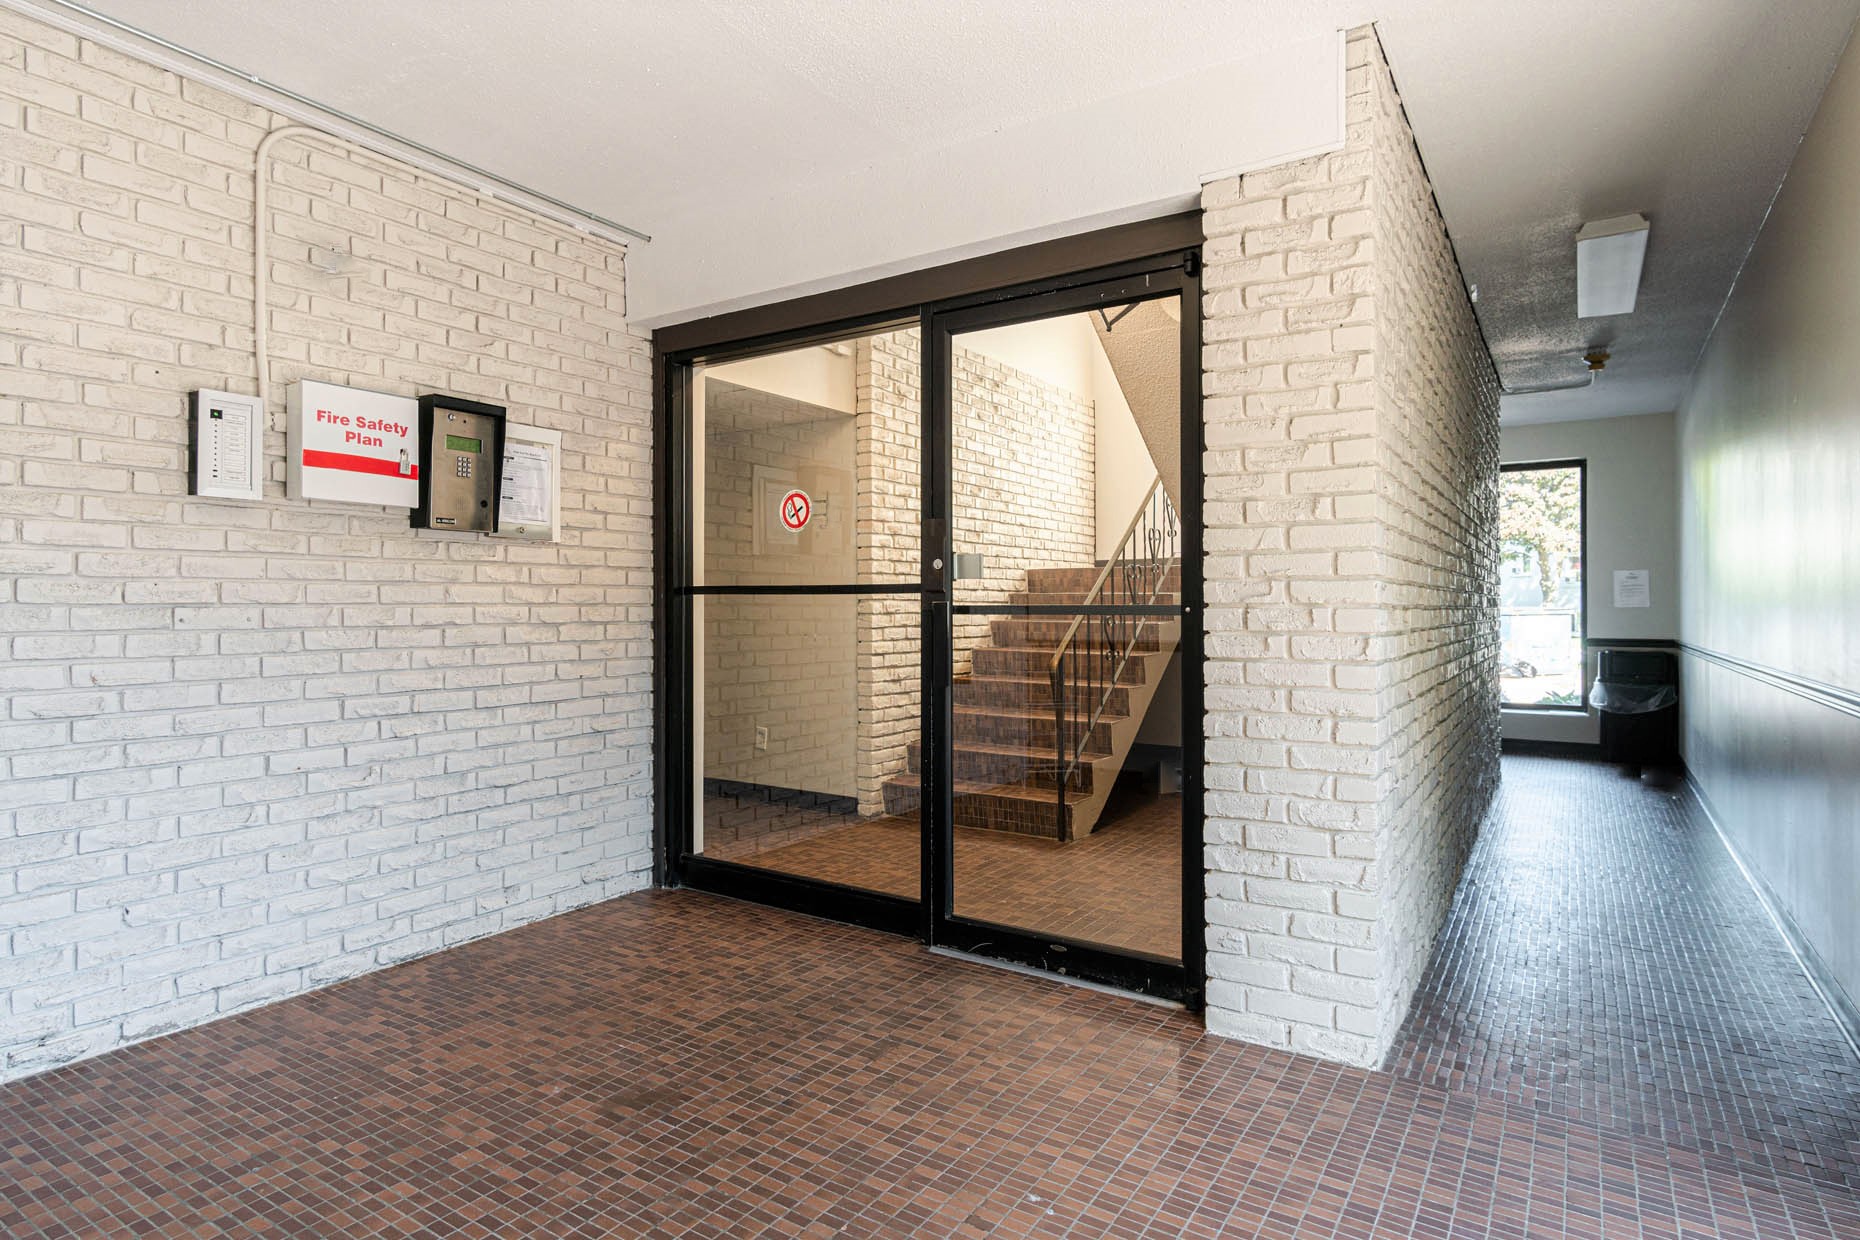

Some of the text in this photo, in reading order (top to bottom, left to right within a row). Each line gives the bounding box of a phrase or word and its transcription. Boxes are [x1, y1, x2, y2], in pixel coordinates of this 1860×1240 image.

[316, 409, 409, 438] Fire Safety
[345, 430, 383, 448] Plan
